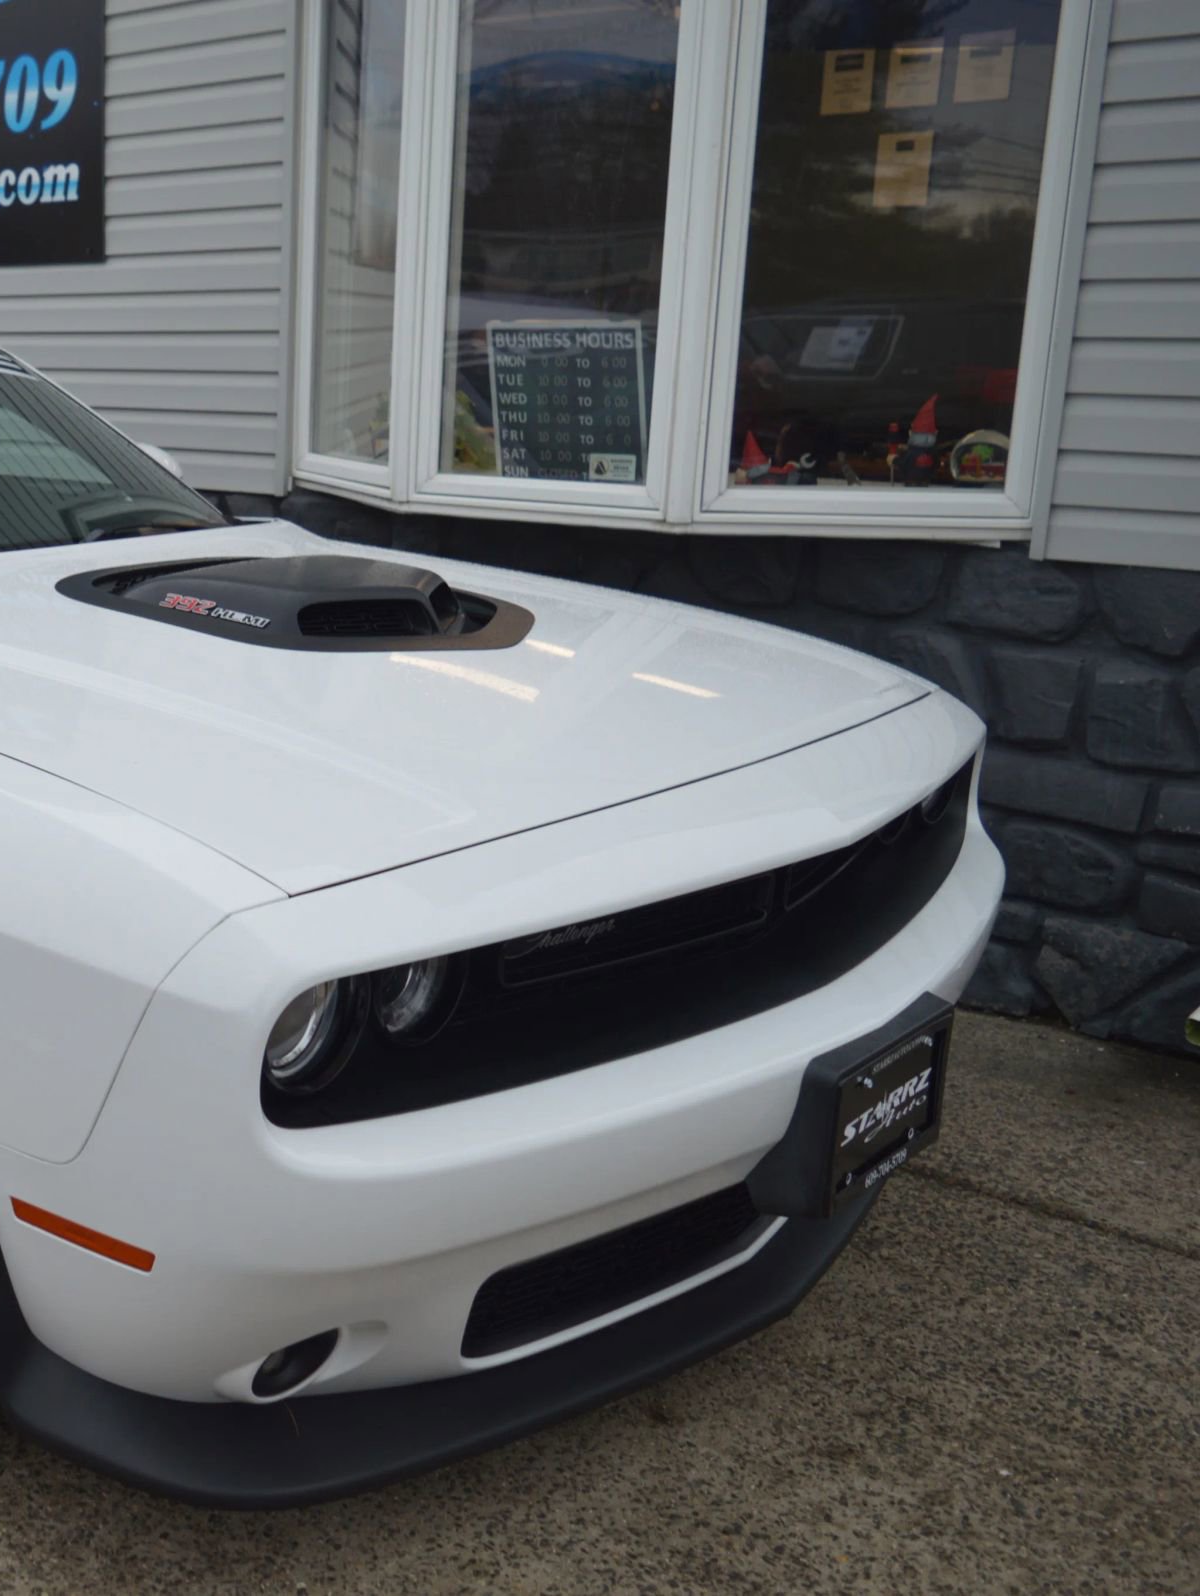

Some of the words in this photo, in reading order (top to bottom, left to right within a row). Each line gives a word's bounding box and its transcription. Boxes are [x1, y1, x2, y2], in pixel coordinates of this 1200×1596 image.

[495, 333, 571, 349] BUSINESS
[575, 332, 634, 349] HOURS
[496, 355, 527, 368] MON
[576, 358, 590, 368] TO
[498, 374, 524, 386] TUE
[577, 377, 591, 388] TO
[499, 393, 527, 405] WED
[578, 397, 592, 407] TO
[500, 411, 527, 423] THU
[579, 416, 593, 426] TO
[502, 430, 524, 441] FRI
[580, 435, 594, 445] TO
[503, 448, 527, 459] SAT
[504, 465, 529, 477] SUN
[159, 592, 216, 615] 392
[840, 1067, 932, 1148] STARRZ
